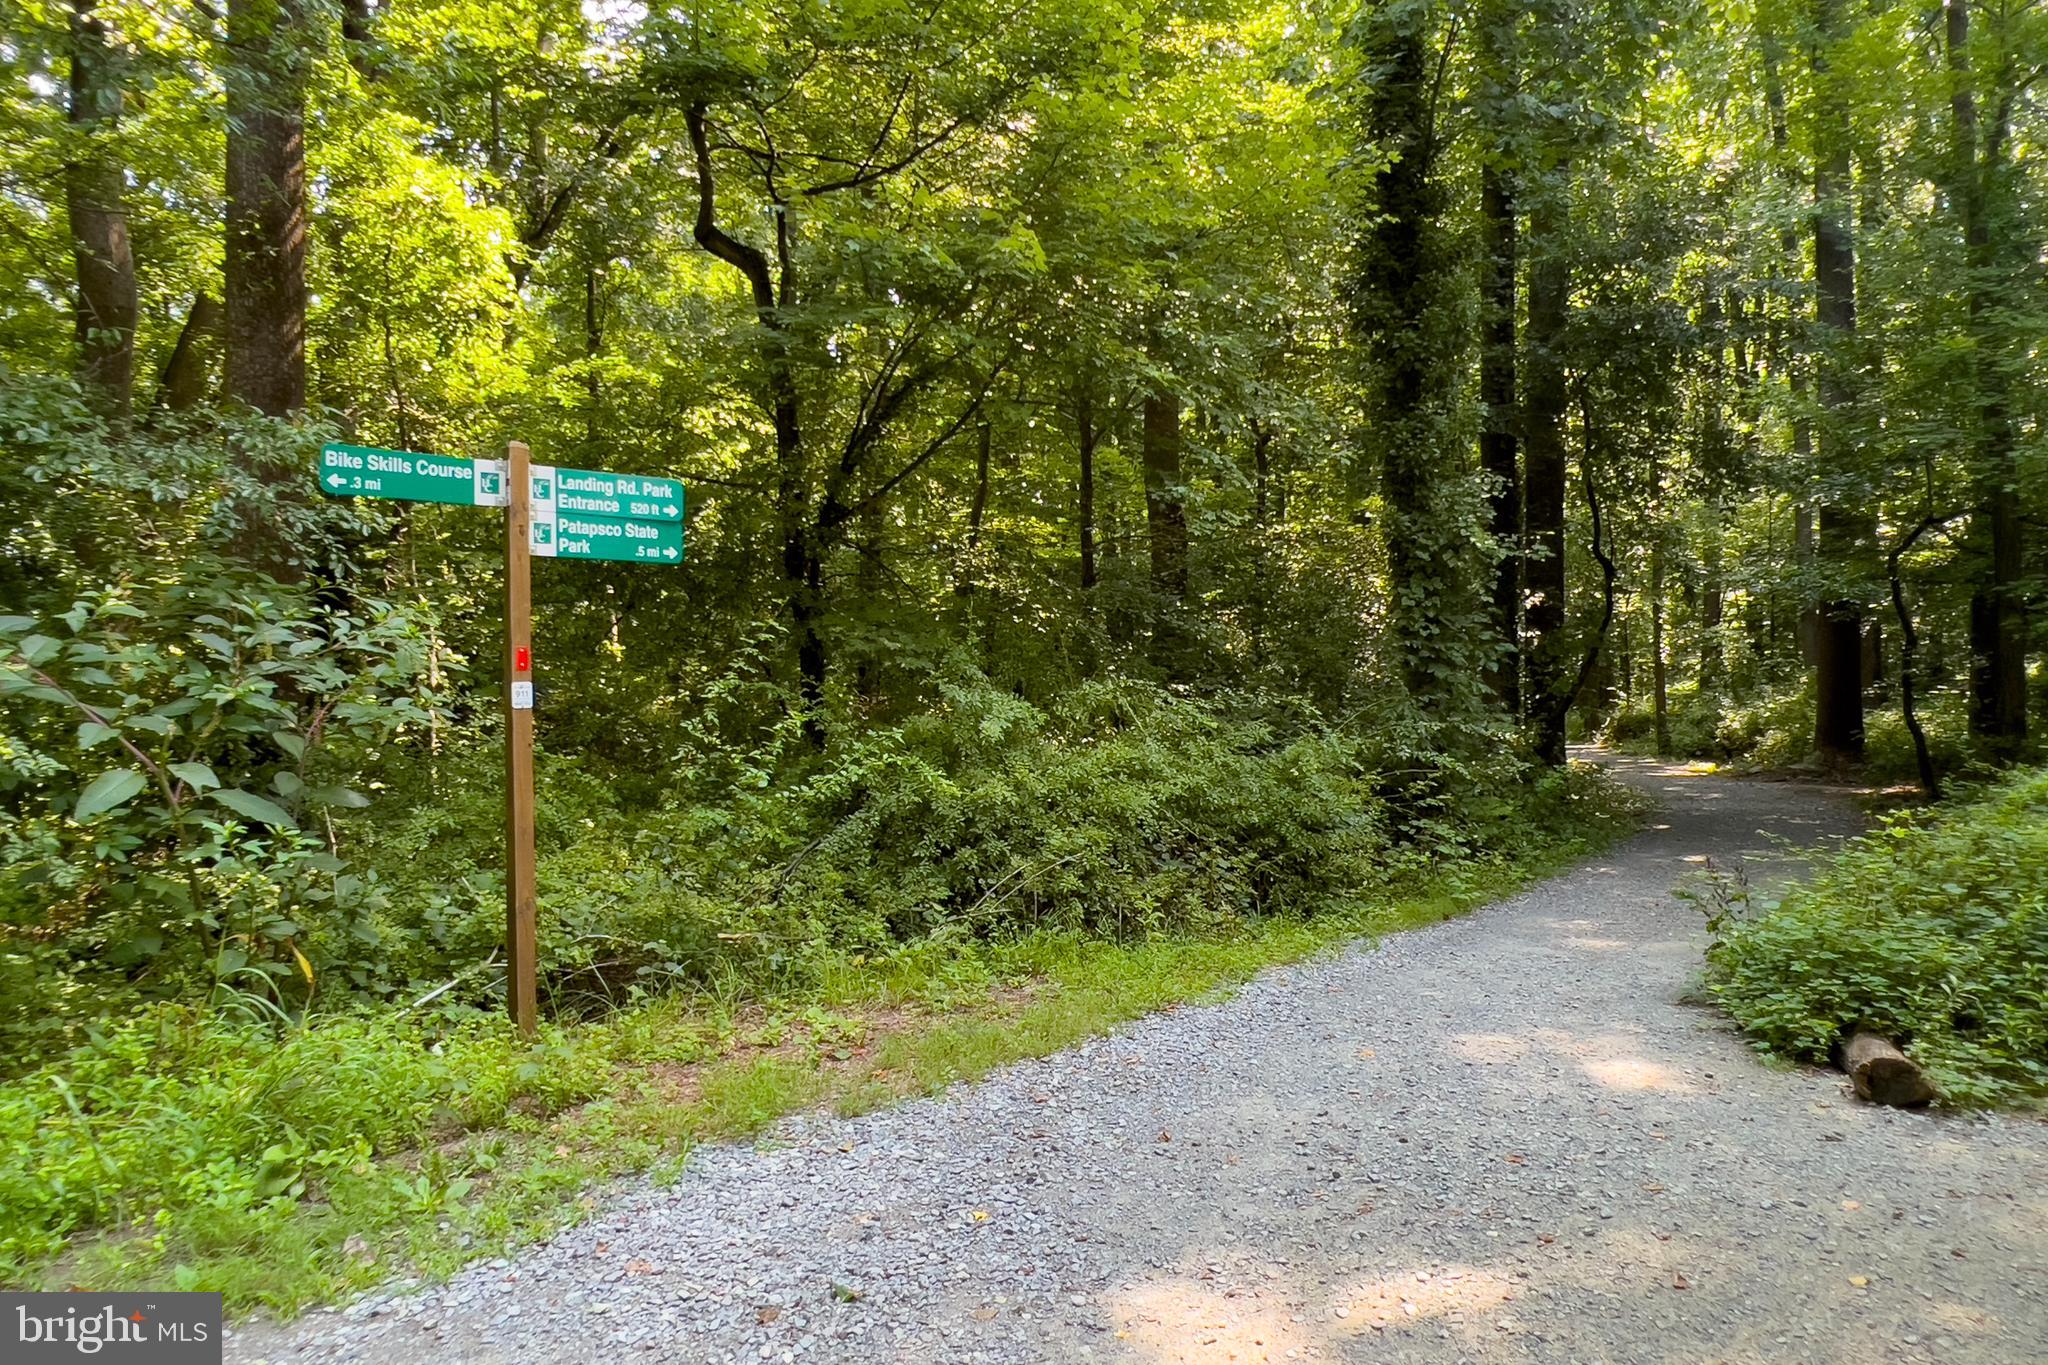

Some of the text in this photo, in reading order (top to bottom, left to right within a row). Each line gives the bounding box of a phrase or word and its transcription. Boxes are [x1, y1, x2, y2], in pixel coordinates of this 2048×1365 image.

[325, 450, 472, 479] Bike Skills Course
[350, 477, 381, 490] .3 mi
[558, 475, 613, 496] Landing
[617, 480, 639, 495] Rd.
[643, 482, 672, 498] Park
[559, 494, 659, 515] Entrance 520 ft
[559, 519, 622, 537] Patapsco
[625, 523, 658, 539] State
[559, 538, 591, 553] Park
[635, 546, 659, 557] .5 mi
